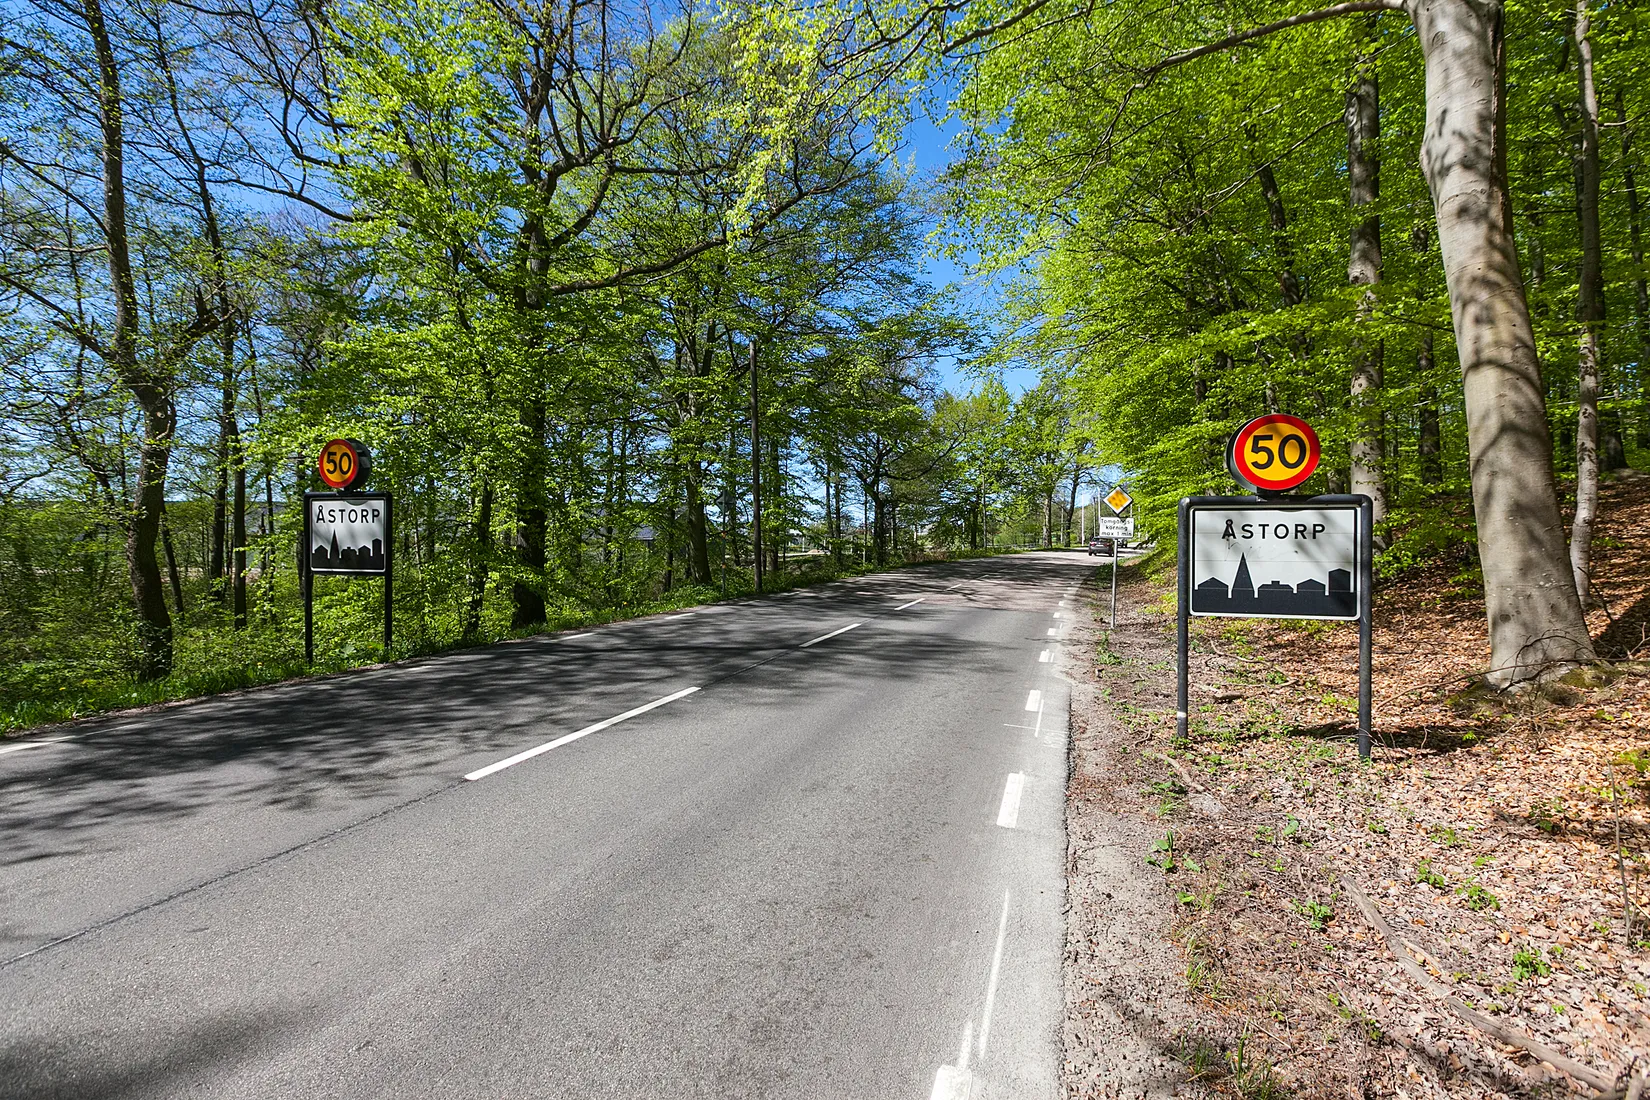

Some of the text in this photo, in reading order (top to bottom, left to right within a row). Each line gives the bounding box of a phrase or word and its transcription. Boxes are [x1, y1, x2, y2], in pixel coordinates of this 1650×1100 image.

[1250, 434, 1306, 469] 50
[326, 452, 352, 475] 50
[316, 505, 380, 523] ÅSTORP
[1222, 519, 1326, 539] ÅSTORP
